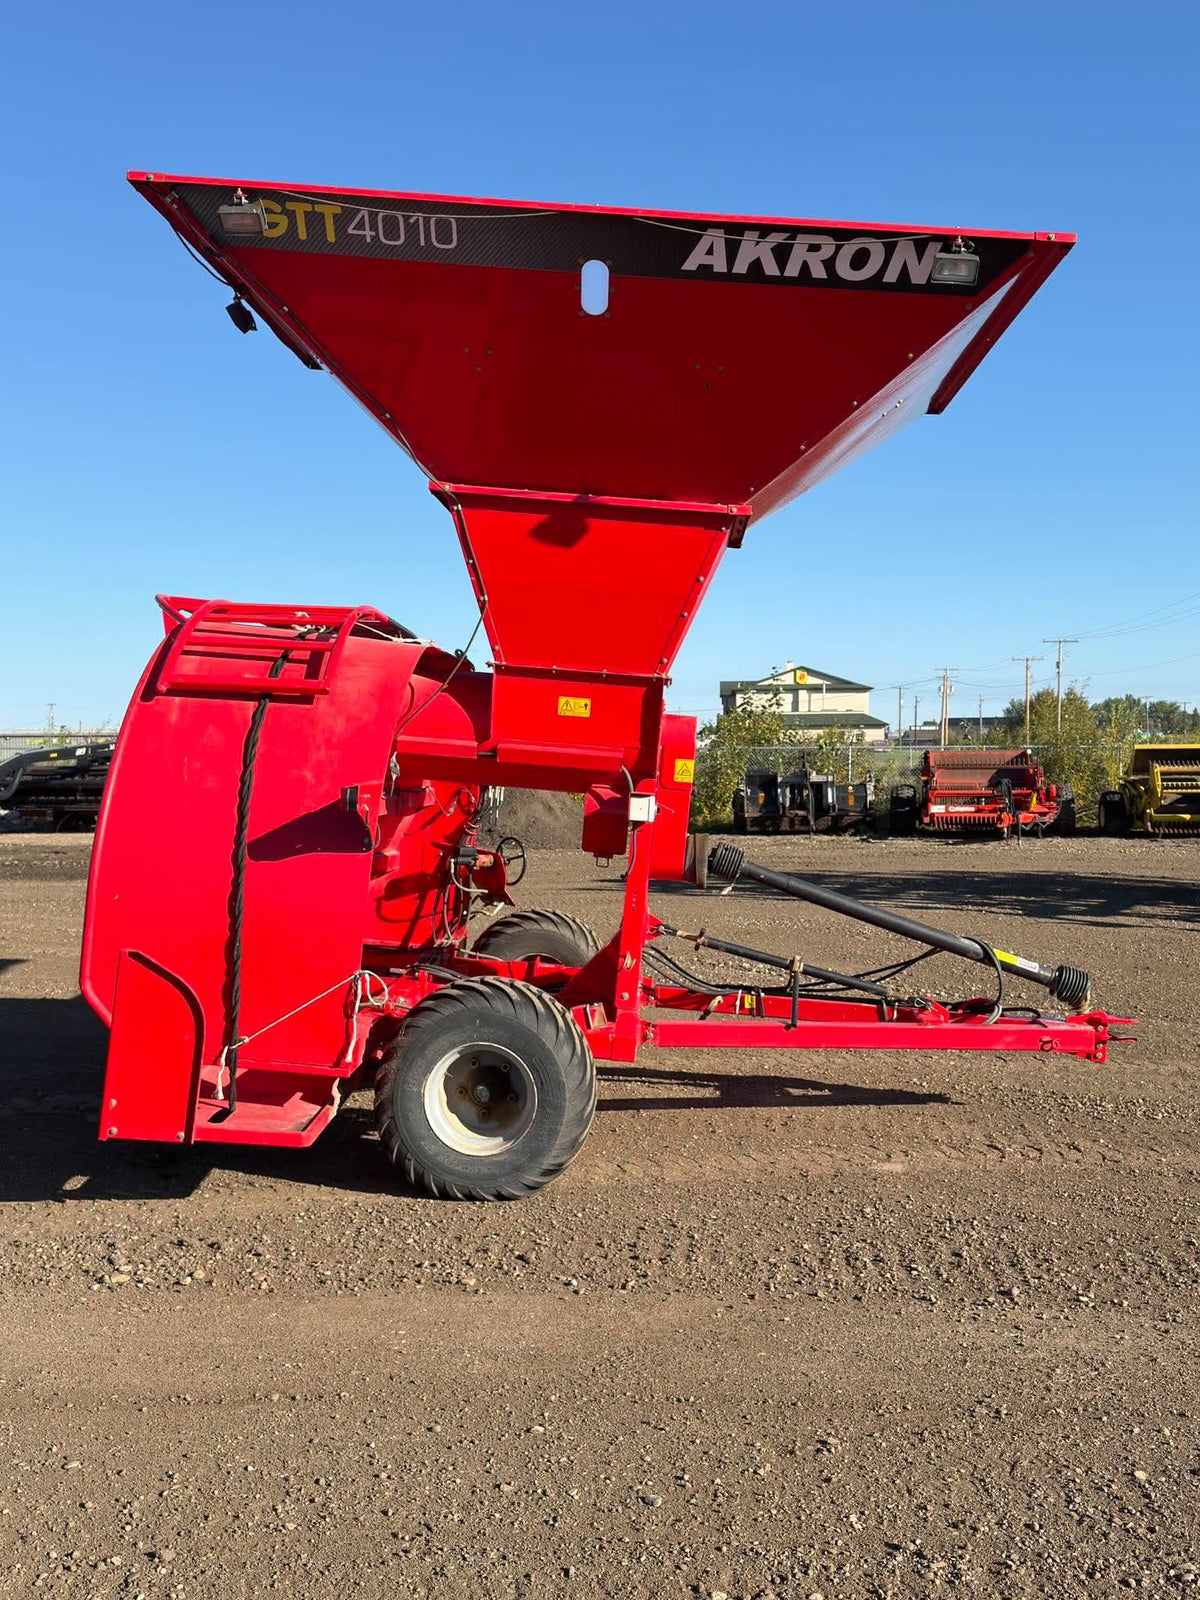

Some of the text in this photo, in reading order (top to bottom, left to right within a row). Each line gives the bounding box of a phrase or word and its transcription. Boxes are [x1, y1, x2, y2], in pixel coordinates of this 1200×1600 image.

[254, 199, 458, 250] GTT 4010
[680, 227, 943, 285] AKRON
